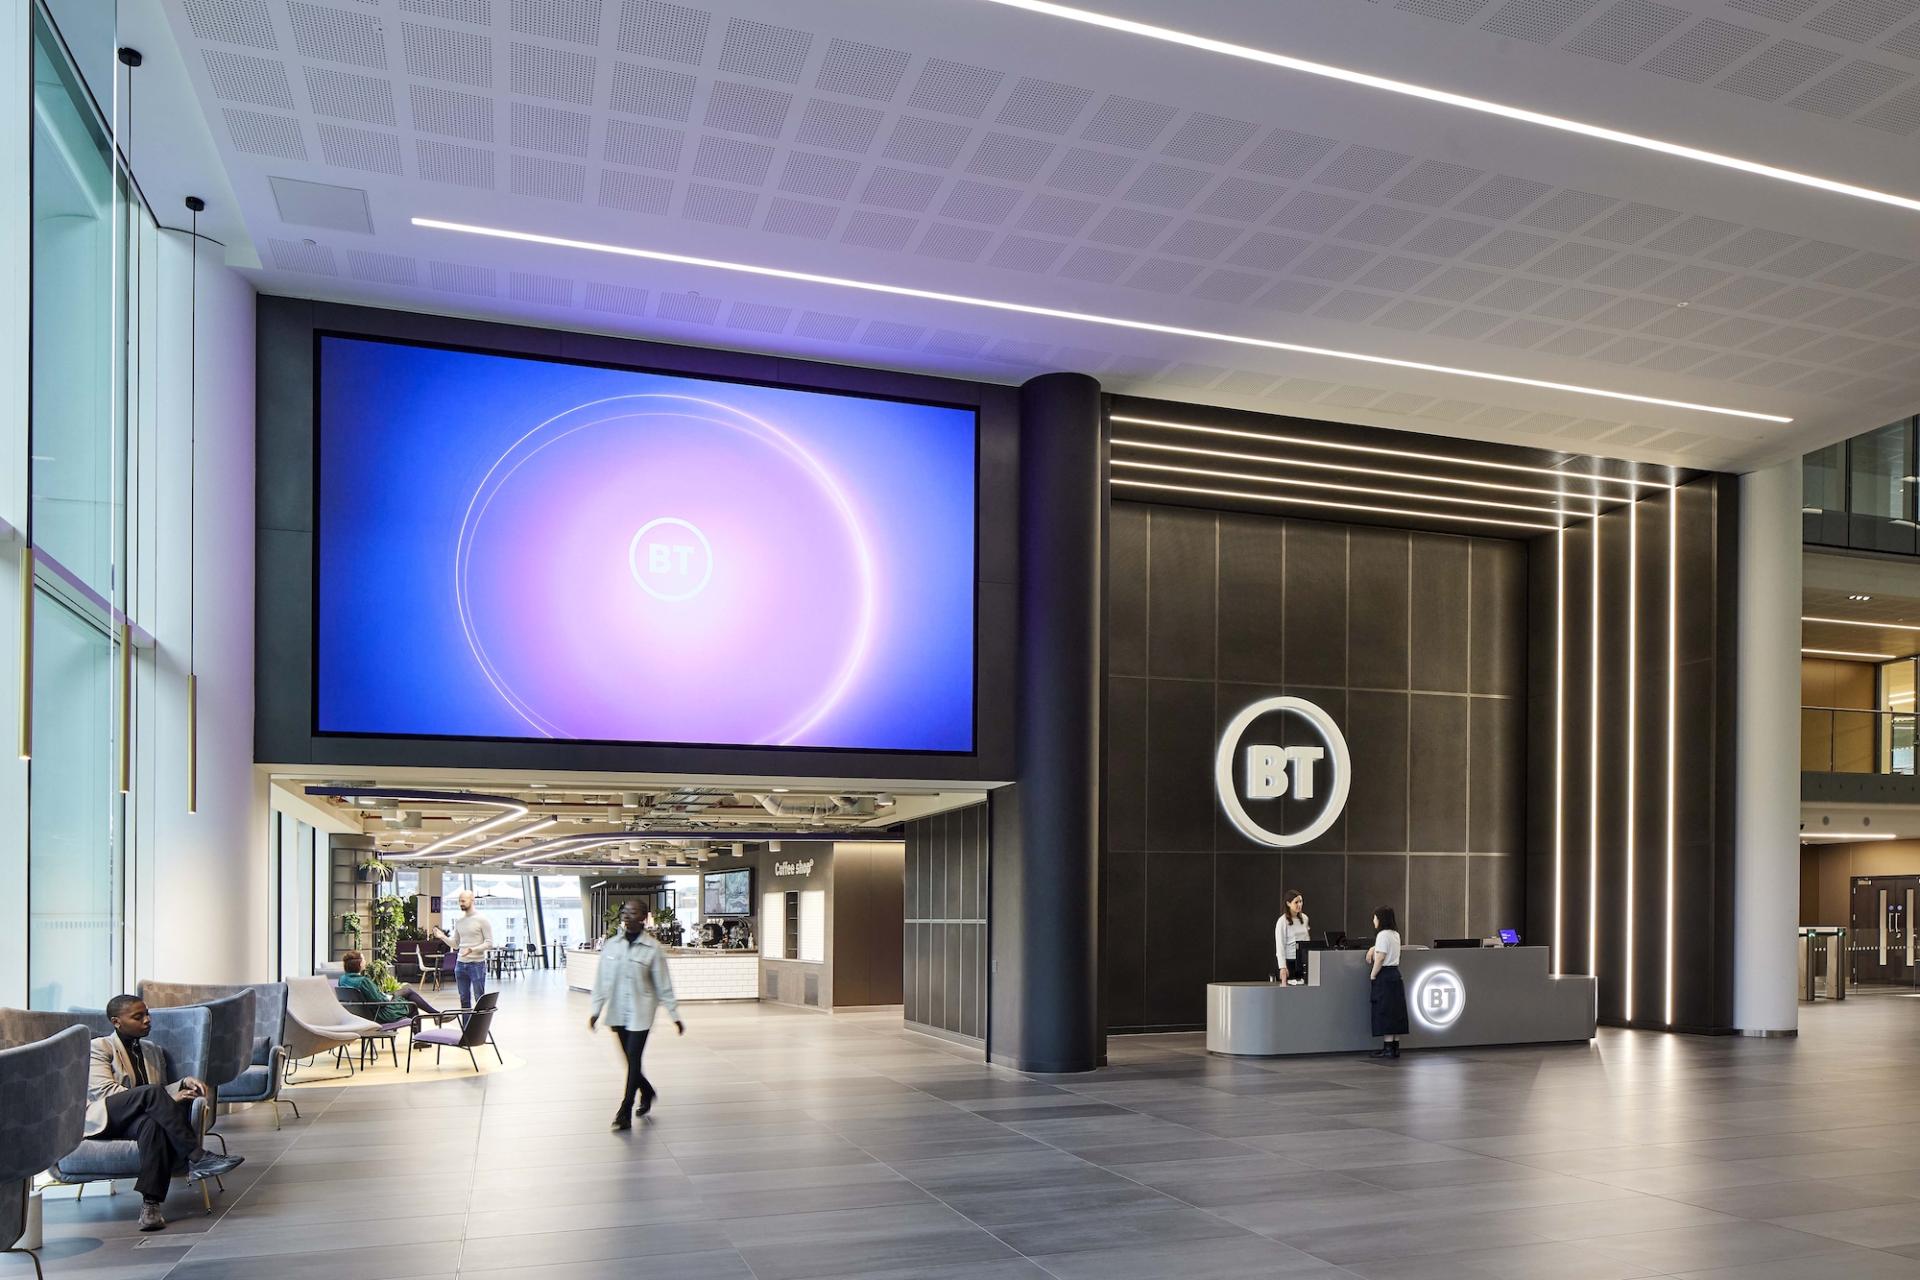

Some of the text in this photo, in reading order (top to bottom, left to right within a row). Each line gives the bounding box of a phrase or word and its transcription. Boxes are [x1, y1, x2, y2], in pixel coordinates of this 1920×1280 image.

[648, 543, 696, 576] BT
[1247, 744, 1325, 800] BT
[775, 861, 795, 876] Coffee
[1429, 988, 1456, 1009] BT
